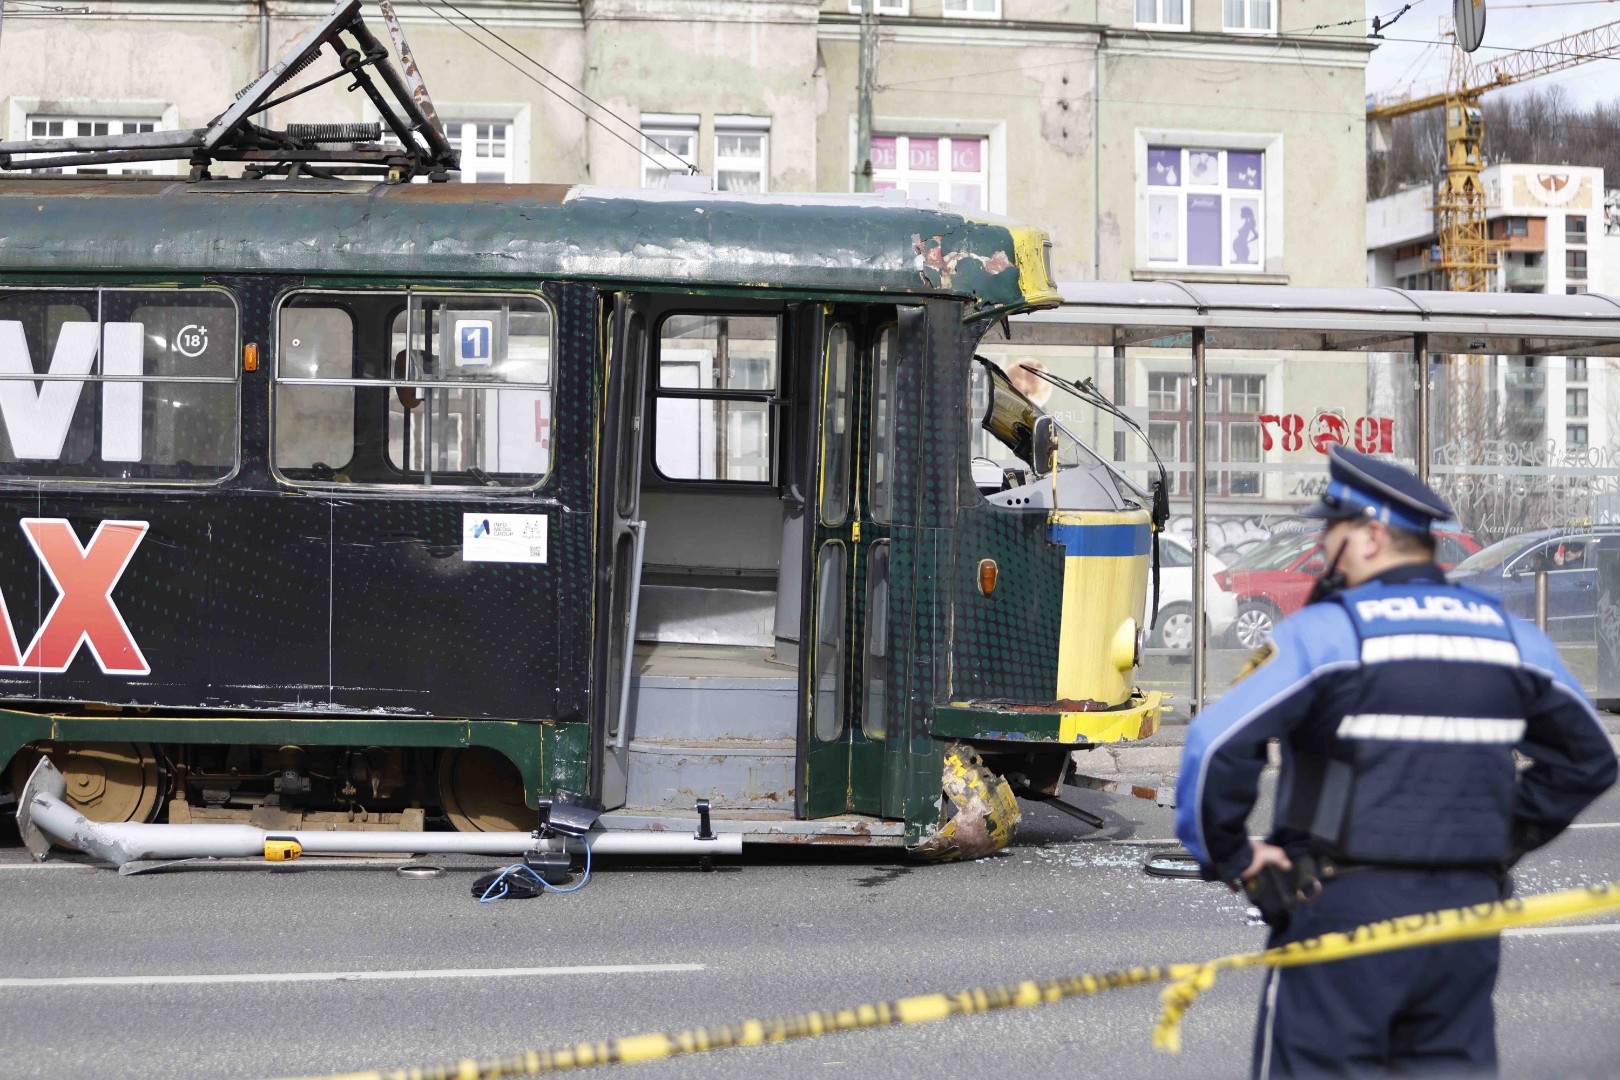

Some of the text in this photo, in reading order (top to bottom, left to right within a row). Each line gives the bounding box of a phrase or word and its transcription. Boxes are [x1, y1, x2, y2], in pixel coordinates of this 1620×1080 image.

[467, 328, 482, 357] 1
[0, 517, 151, 675] X
[1355, 595, 1505, 627] POLICIJA
